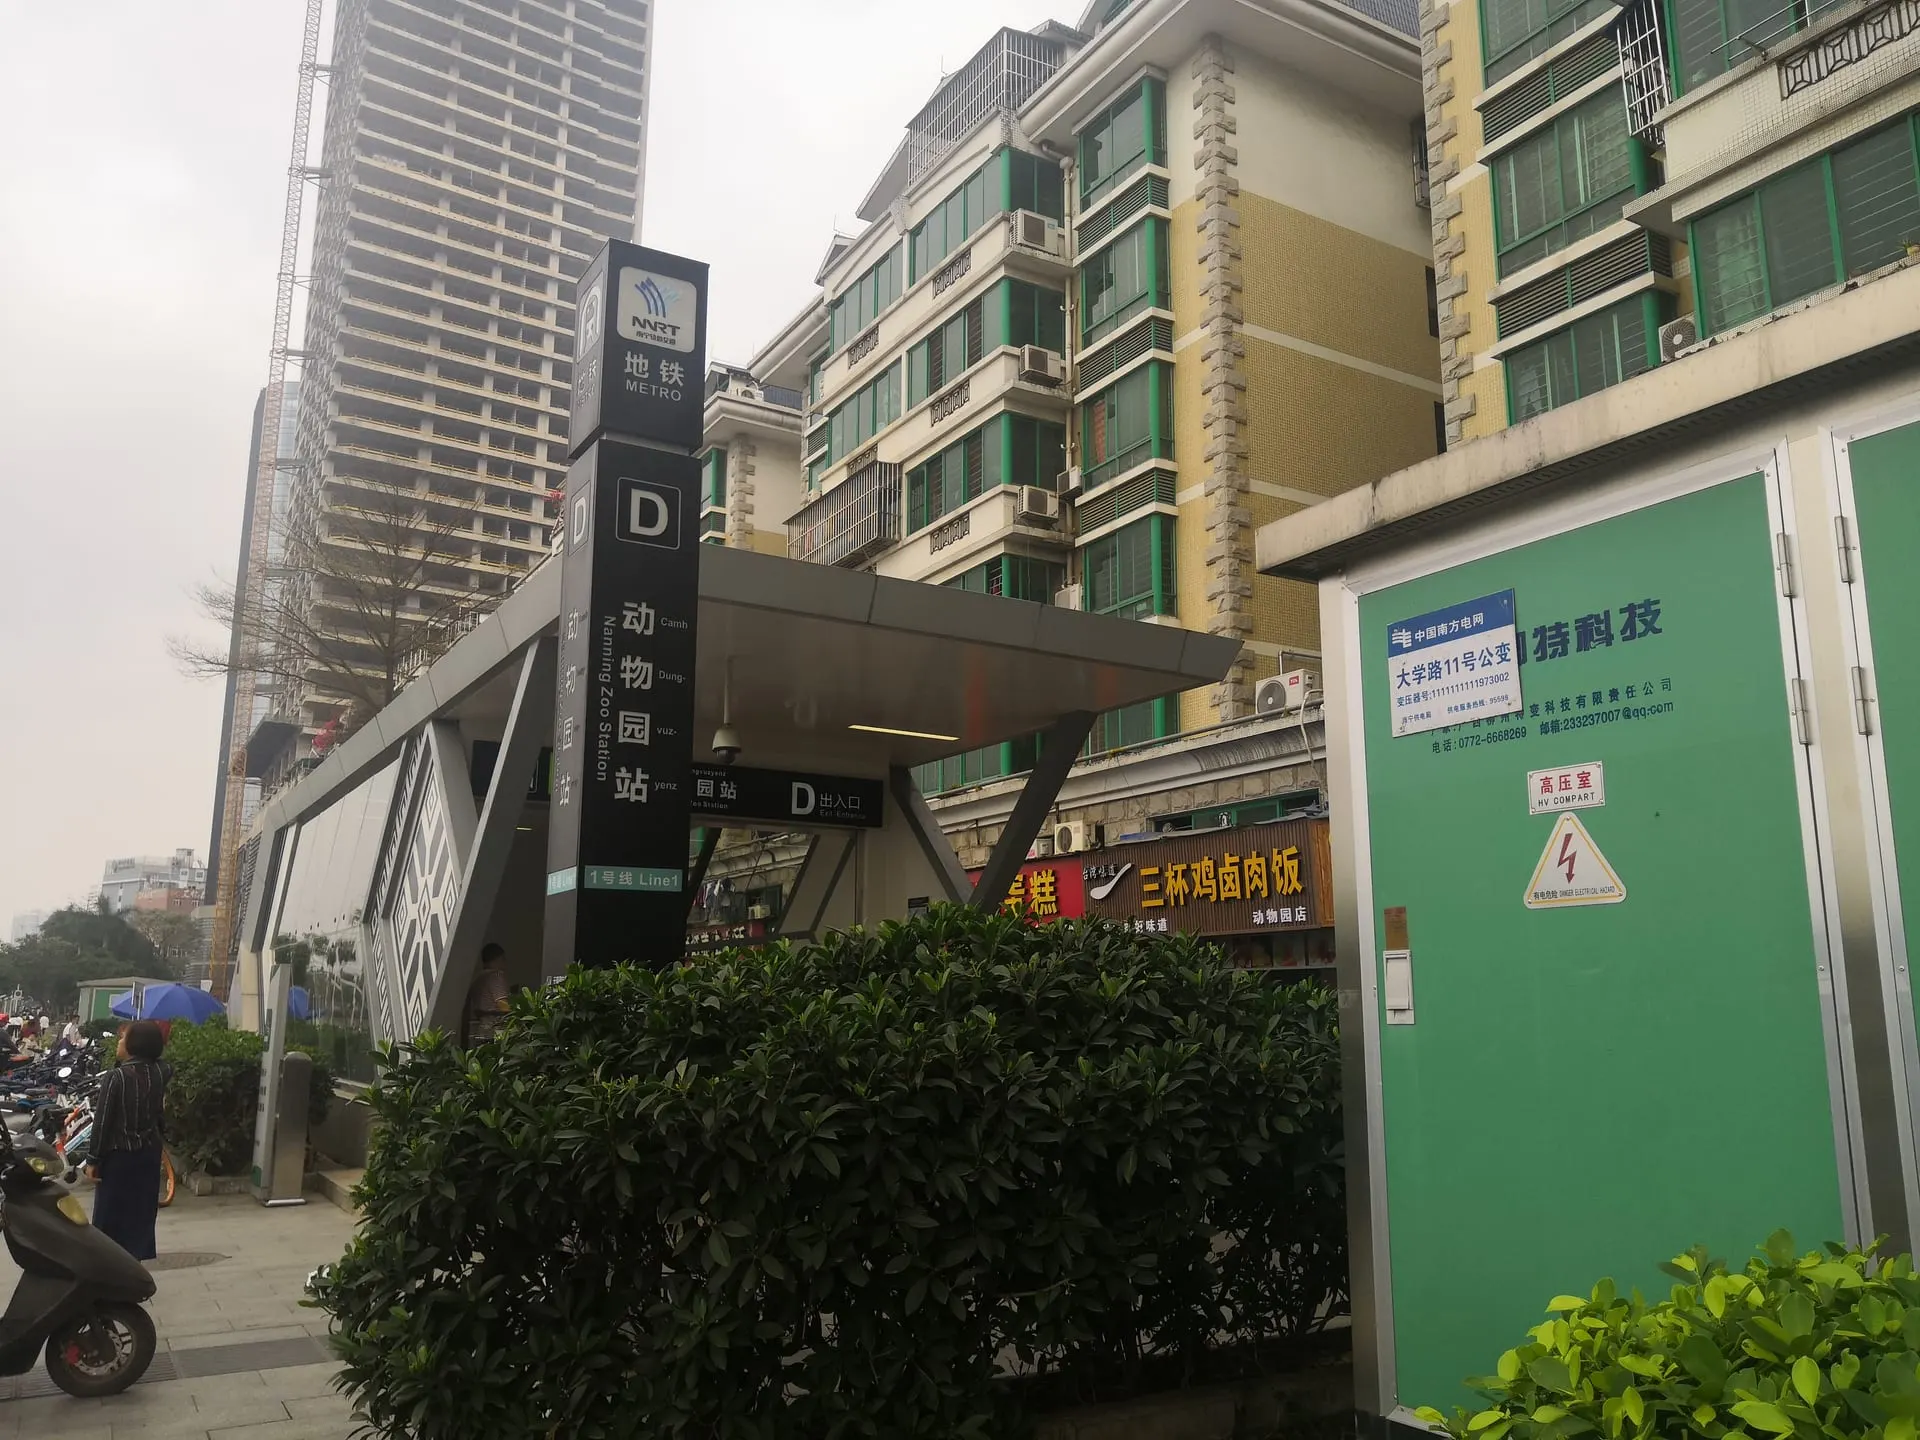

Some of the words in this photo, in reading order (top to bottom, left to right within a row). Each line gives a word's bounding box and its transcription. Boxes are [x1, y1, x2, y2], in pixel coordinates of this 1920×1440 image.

[624, 351, 685, 387] 地铁
[626, 379, 682, 402] METRO
[573, 496, 586, 545] D
[630, 488, 669, 536] D
[660, 617, 688, 630] Camh
[1414, 612, 1484, 643] 中国南方电网
[599, 615, 617, 682] Nanning
[1396, 642, 1512, 690] 大学路11号公变
[559, 608, 579, 806] 动物园站
[600, 686, 614, 717] Zoo
[614, 601, 655, 803] 动物园站
[597, 722, 613, 781] Station
[1432, 726, 1527, 754] 电话:0772-6668269
[654, 781, 678, 792] yenz
[697, 779, 737, 800] 园站
[791, 781, 816, 815] D
[1540, 771, 1593, 795] 高压室
[820, 792, 860, 809] 出入口
[1538, 798, 1549, 807] HV
[1553, 792, 1596, 805] COMPART
[590, 870, 633, 886] 1号线
[639, 872, 678, 887] Line1
[1140, 846, 1303, 908] 三杯鸡卤肉饭
[1534, 890, 1558, 900] 有电危险
[1253, 906, 1307, 925] 动物园店
